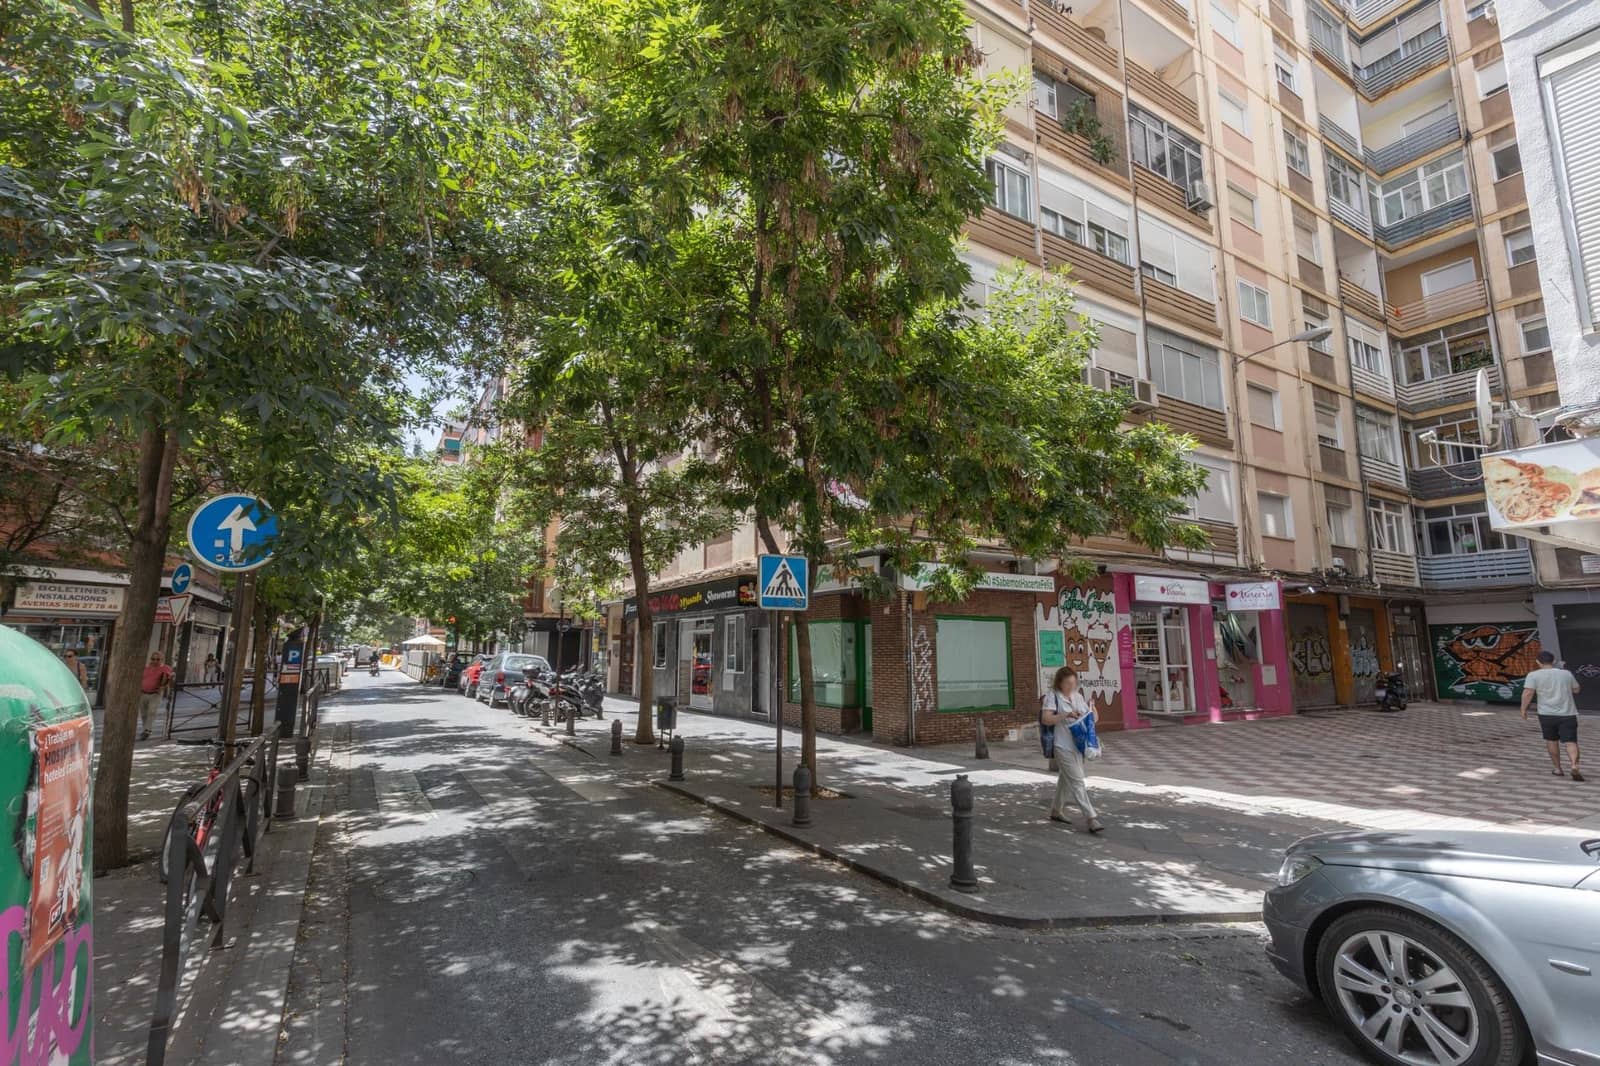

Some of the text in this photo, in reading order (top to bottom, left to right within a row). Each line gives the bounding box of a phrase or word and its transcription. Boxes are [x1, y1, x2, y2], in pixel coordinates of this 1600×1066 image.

[37, 584, 109, 595] BOLETINES
[35, 592, 107, 602] INSTALACIONES
[21, 600, 61, 608] AVERIAS
[288, 650, 300, 662] P
